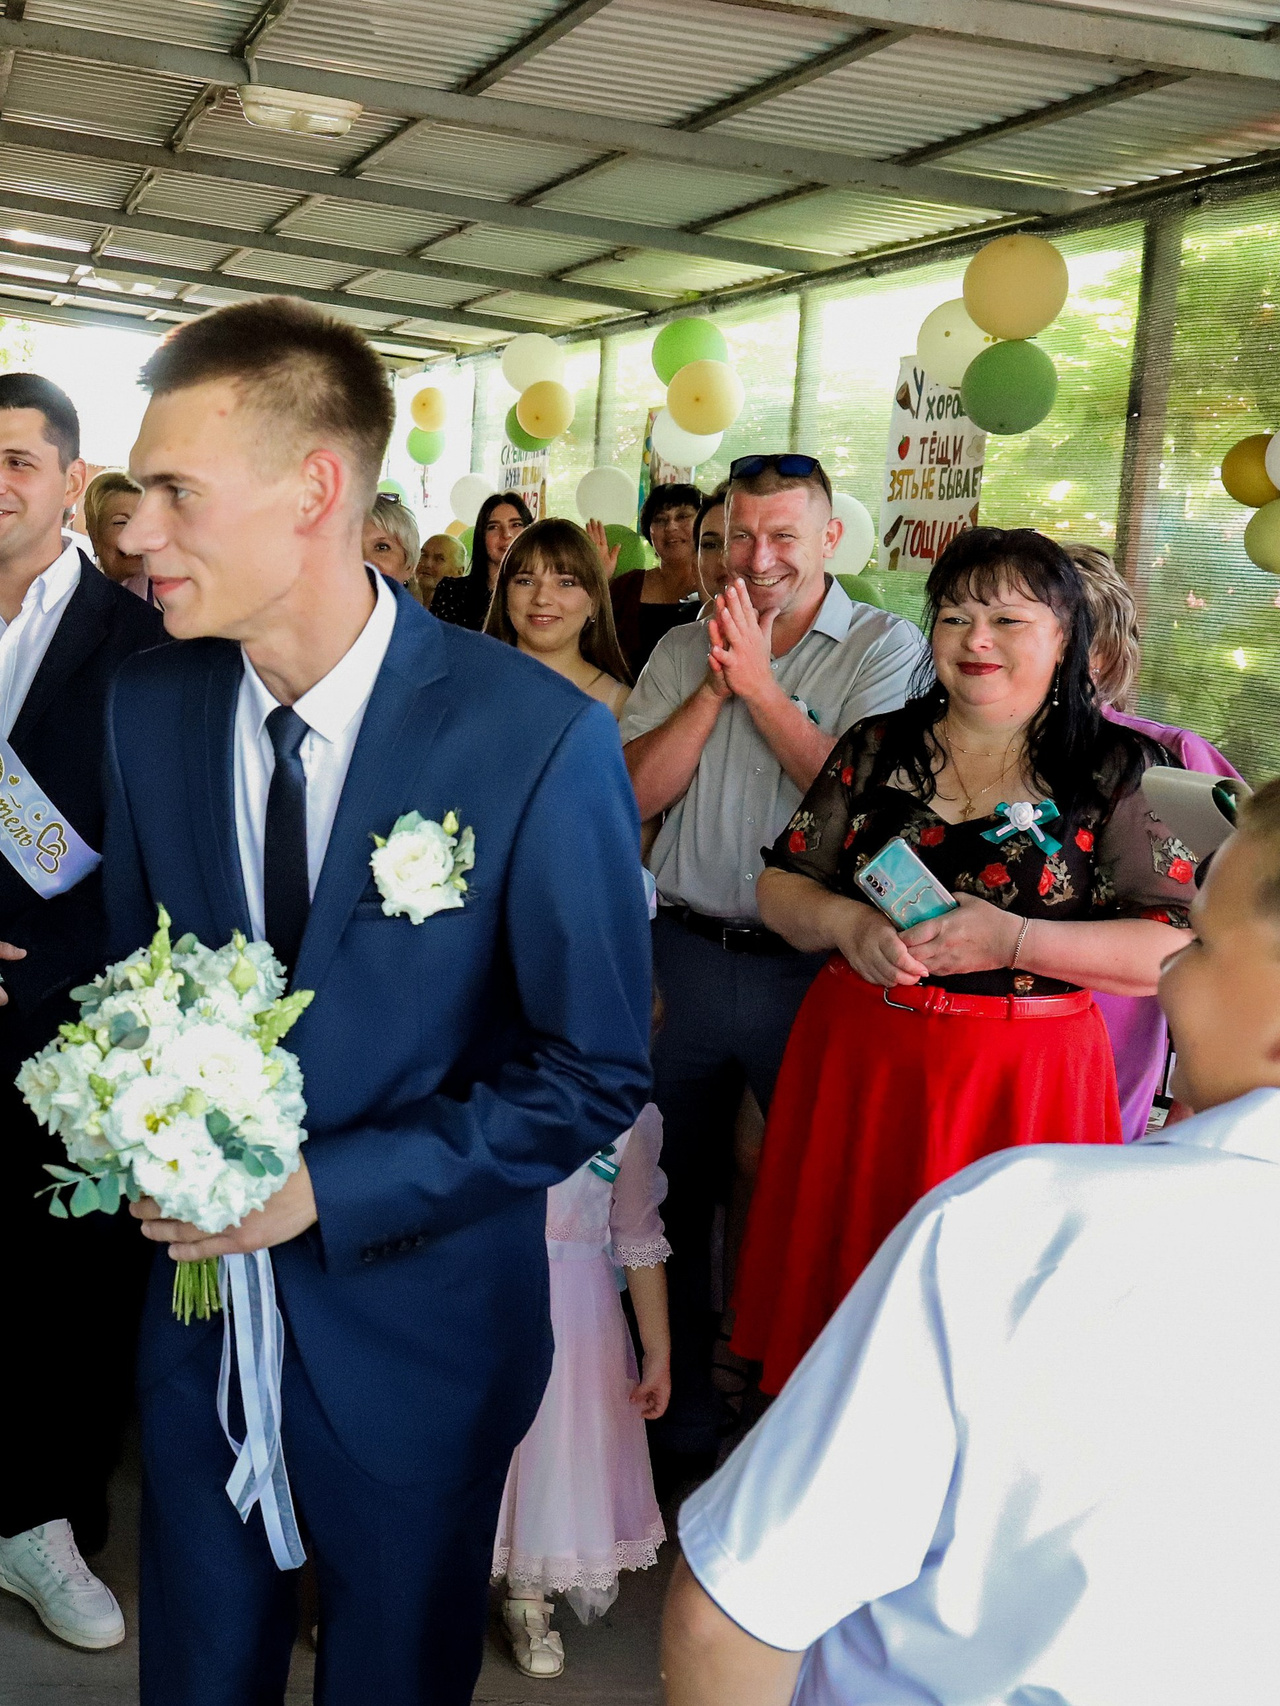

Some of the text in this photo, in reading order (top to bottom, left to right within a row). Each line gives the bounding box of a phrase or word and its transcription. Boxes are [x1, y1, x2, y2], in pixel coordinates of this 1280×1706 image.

[913, 366, 925, 420] У
[926, 392, 967, 423] ХОРО
[920, 431, 964, 468] ТЁЩИ
[887, 468, 917, 502] ЗЯТЬ
[920, 467, 936, 500] НЕ
